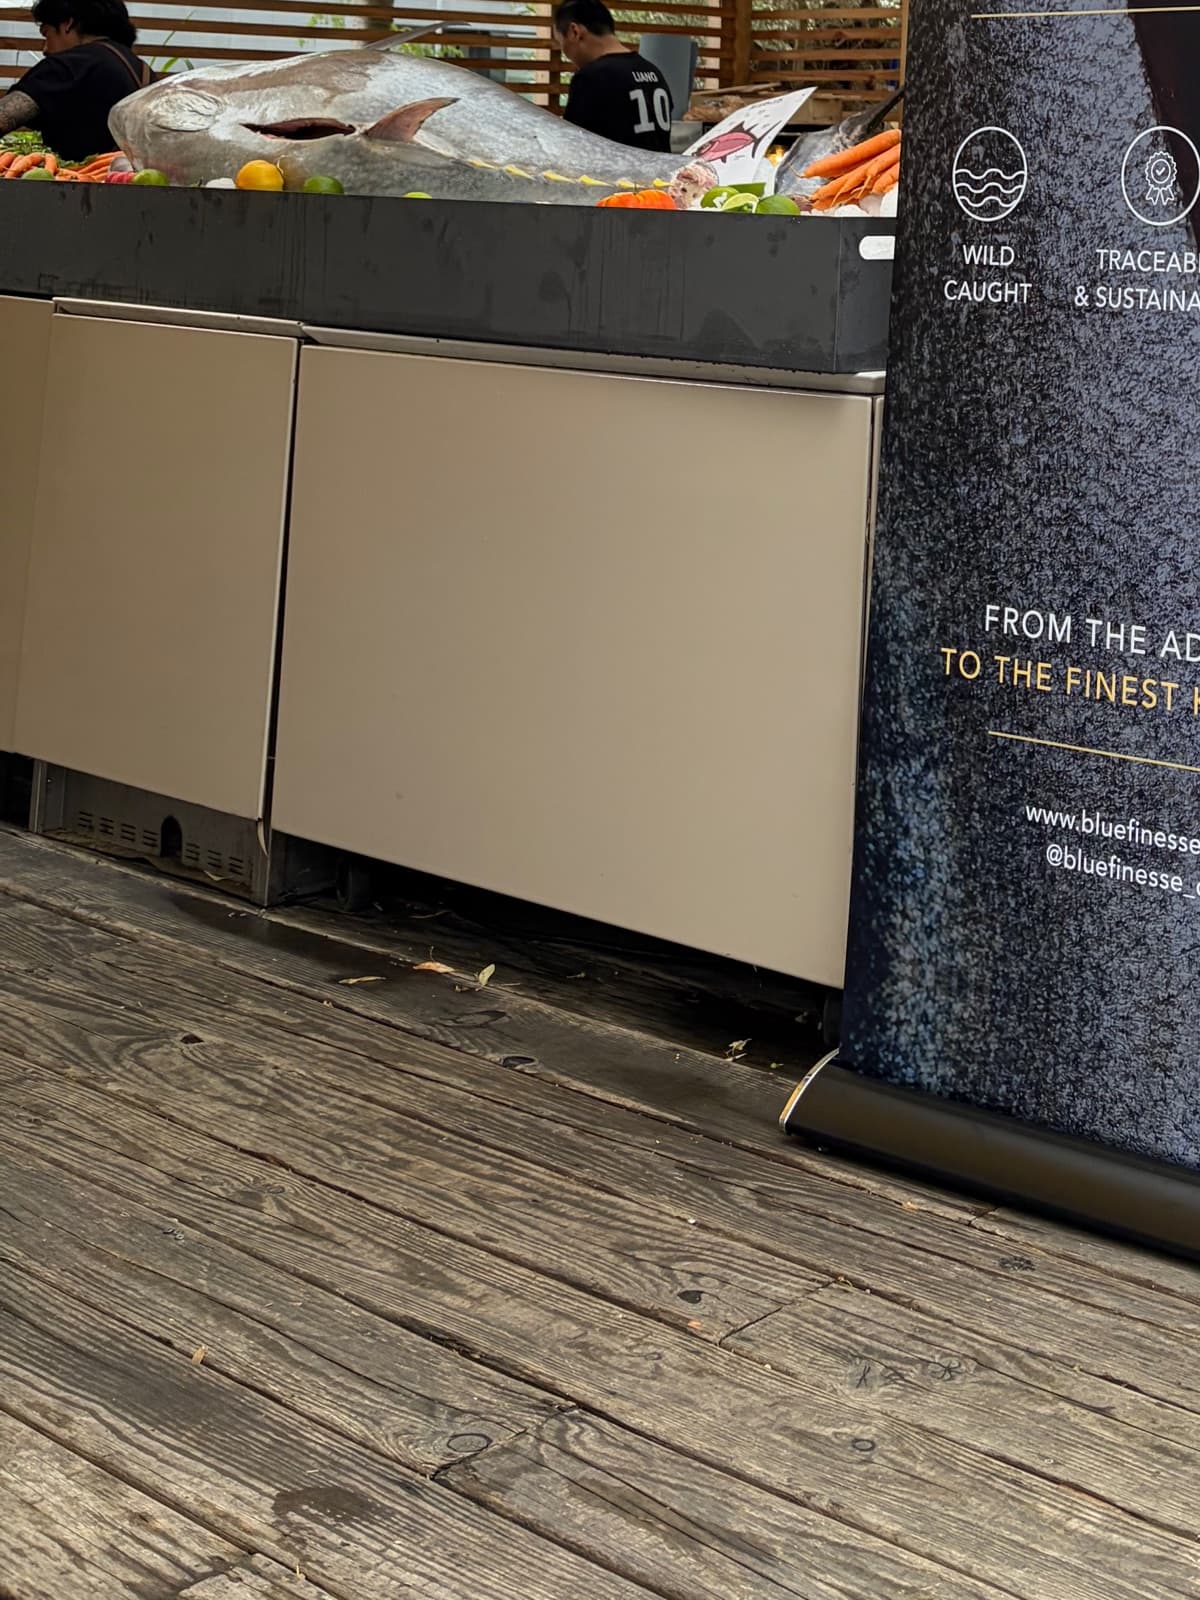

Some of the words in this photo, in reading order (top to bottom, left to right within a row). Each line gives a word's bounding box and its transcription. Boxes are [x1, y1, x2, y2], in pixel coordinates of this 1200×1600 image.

[629, 88, 671, 134] 10
[962, 245, 1014, 267] WILD
[944, 280, 1031, 305] CAUGHT
[1074, 286, 1088, 306] &
[985, 604, 1072, 644] FROM
[1085, 618, 1147, 655] THE
[941, 647, 981, 680] TO
[994, 655, 1052, 692] THE
[1066, 667, 1179, 711] FINEST
